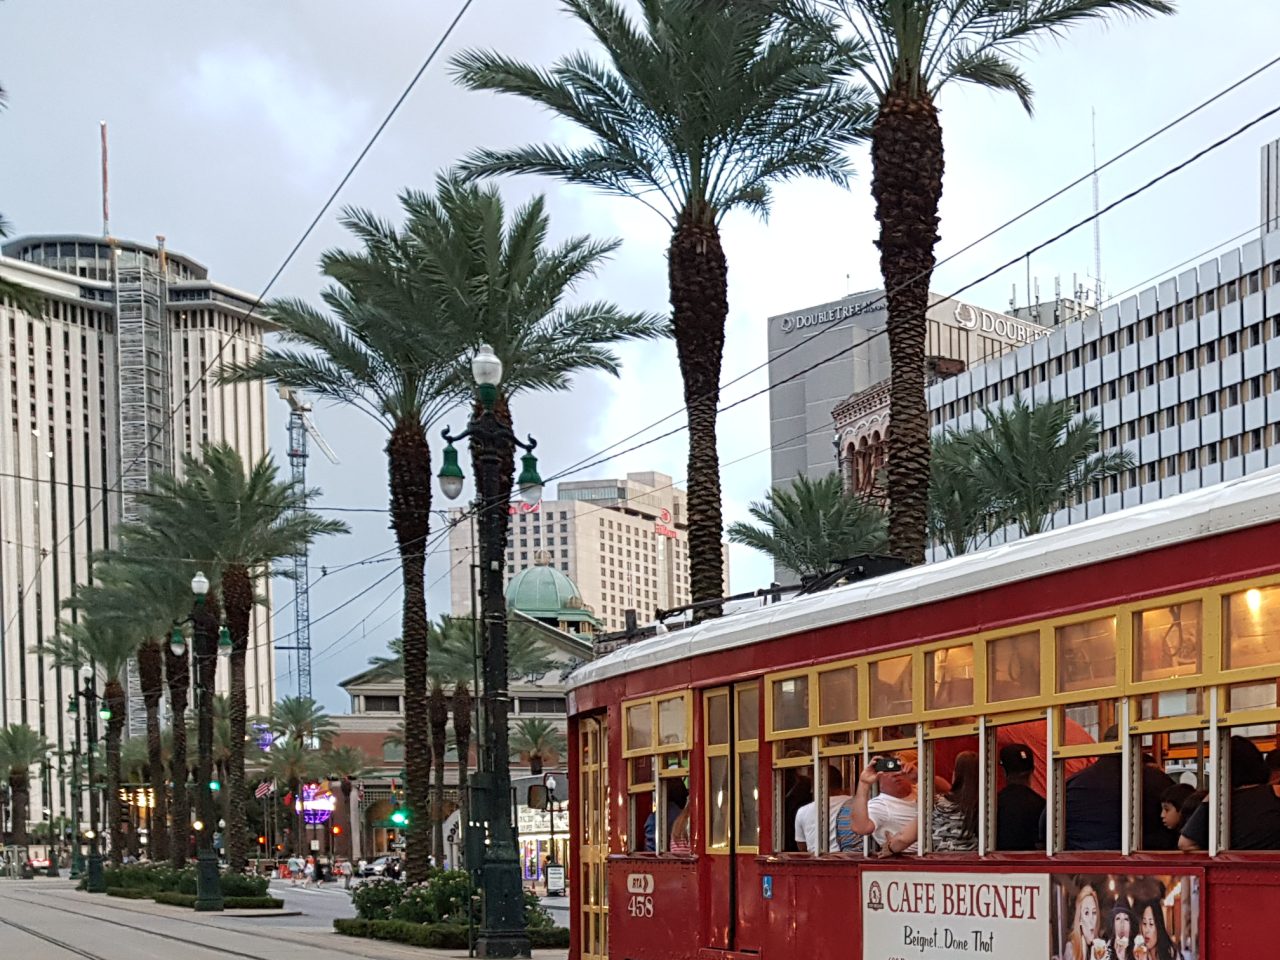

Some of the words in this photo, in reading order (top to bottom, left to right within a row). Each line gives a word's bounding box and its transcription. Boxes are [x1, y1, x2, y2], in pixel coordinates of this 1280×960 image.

[632, 878, 643, 889] RTA
[627, 895, 654, 918] 458
[887, 881, 937, 914] CAFE
[942, 883, 1040, 920] BEIGNET
[971, 930, 994, 953] That
